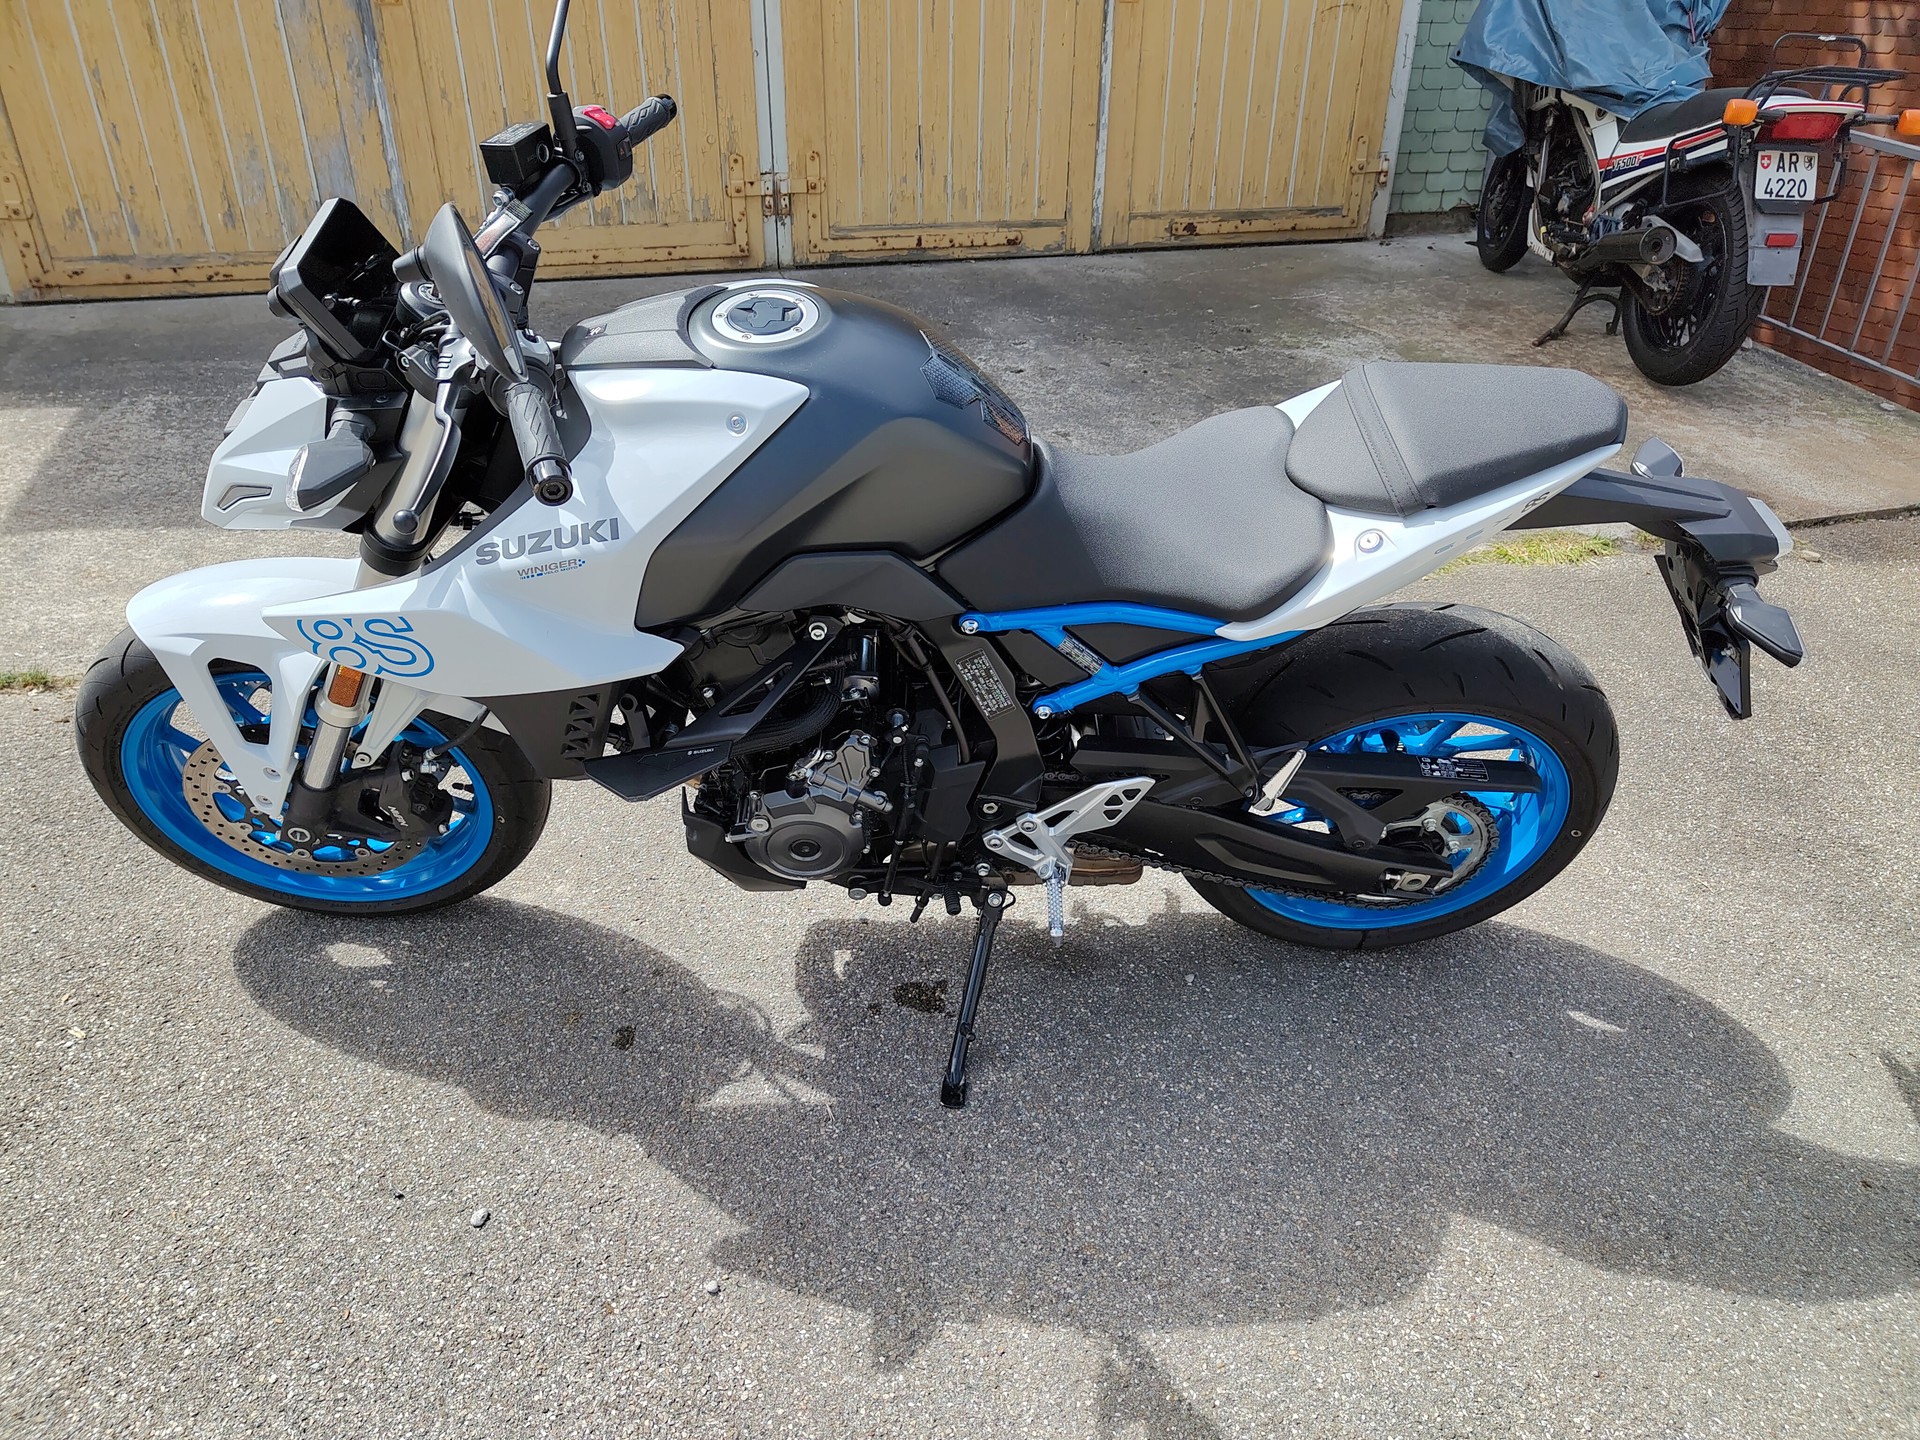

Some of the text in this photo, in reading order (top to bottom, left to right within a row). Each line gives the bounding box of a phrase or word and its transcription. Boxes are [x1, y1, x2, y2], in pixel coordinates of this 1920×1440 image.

[1776, 152, 1799, 173] AR
[1764, 178, 1807, 198] 4220
[475, 517, 620, 566] SUZUKI
[517, 558, 577, 576] WINIGER
[296, 616, 435, 678] 8S
